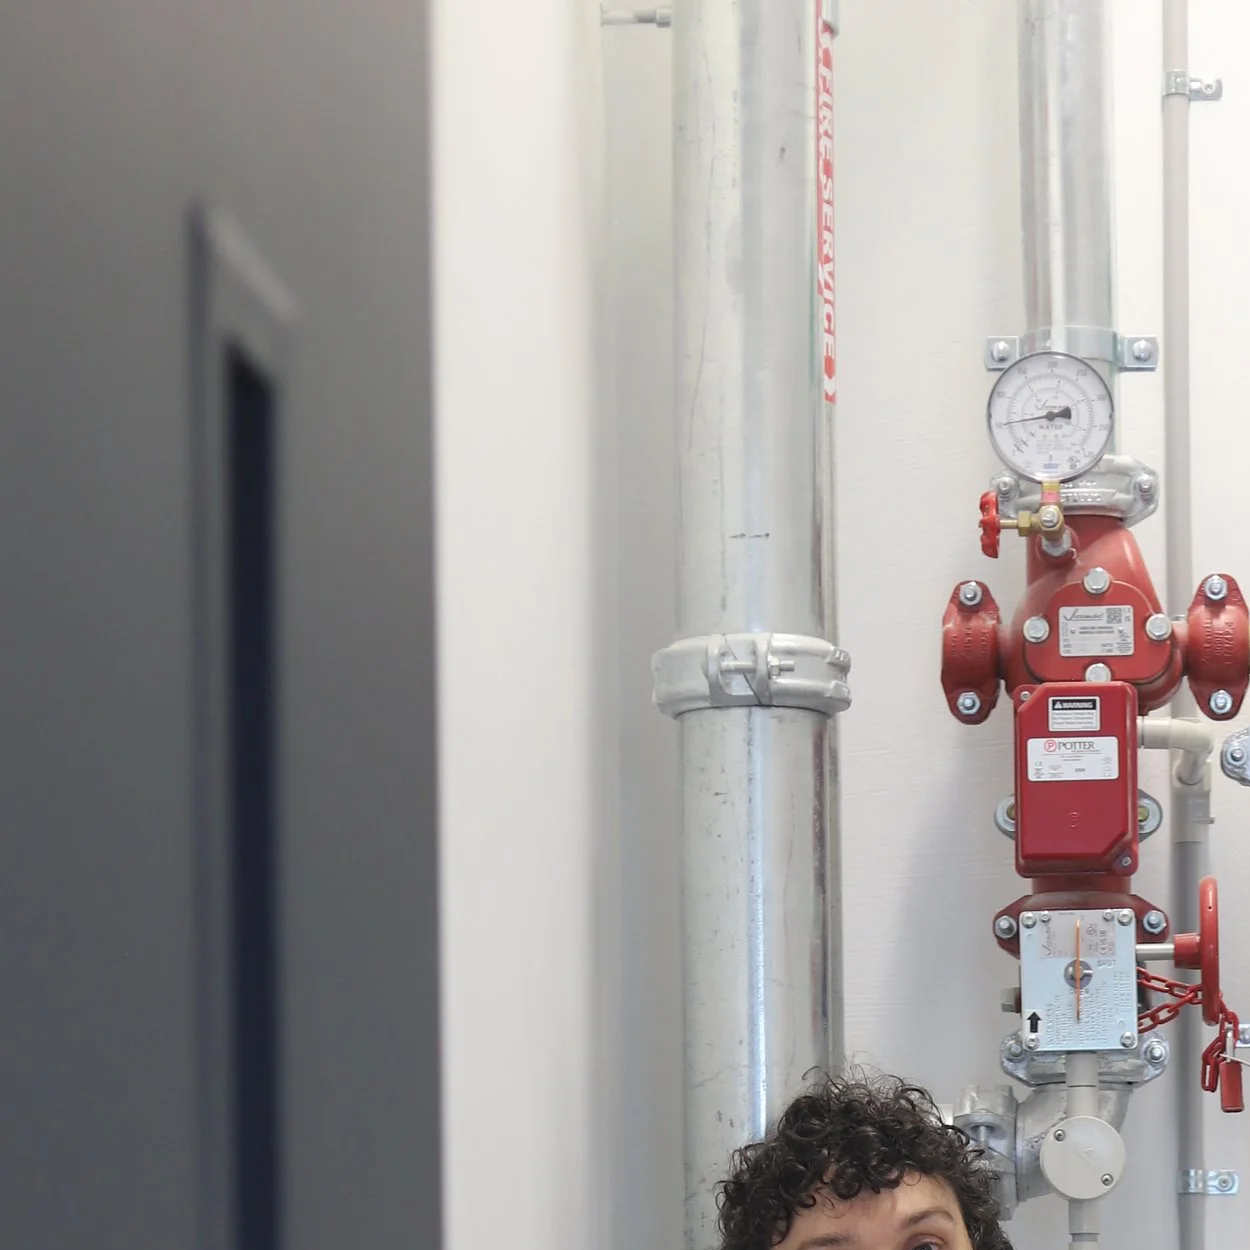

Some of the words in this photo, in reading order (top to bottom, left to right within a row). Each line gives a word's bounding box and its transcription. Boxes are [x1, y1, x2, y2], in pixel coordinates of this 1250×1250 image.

[819, 65, 833, 166] FIRE
[820, 171, 835, 358] SERVICE
[1061, 701, 1094, 709] WARNING
[1058, 741, 1095, 750] POTTER
